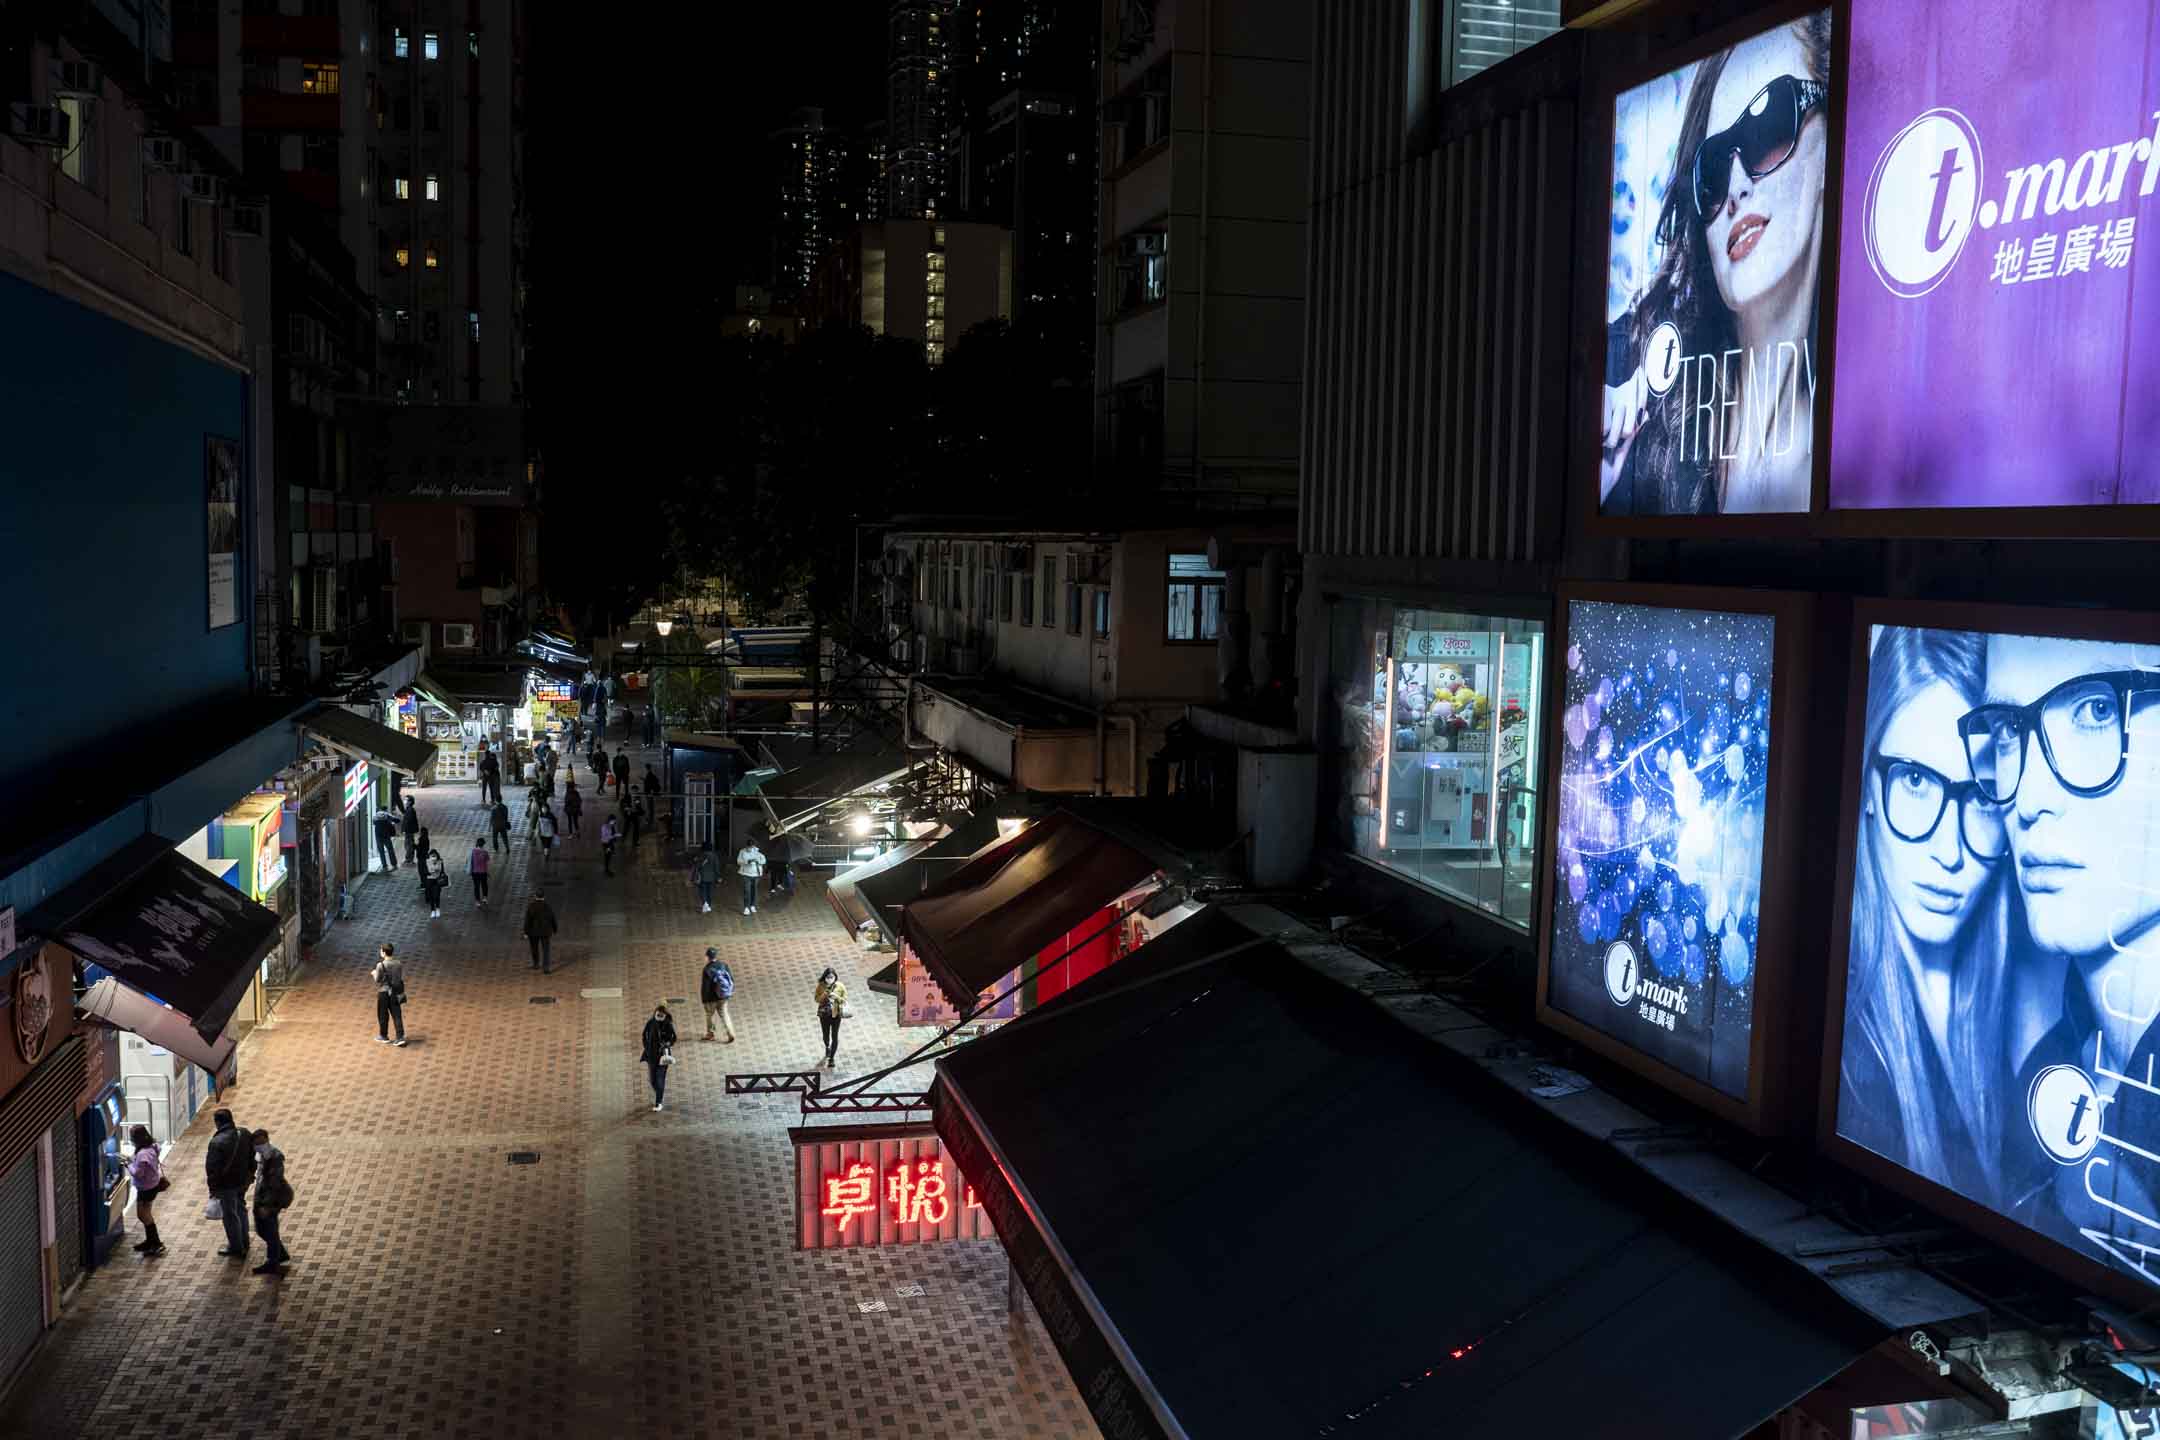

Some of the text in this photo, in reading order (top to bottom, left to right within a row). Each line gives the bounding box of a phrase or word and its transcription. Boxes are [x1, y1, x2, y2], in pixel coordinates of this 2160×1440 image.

[1990, 217, 2136, 285] 地皇廣場
[1678, 338, 1817, 462] TRENDY
